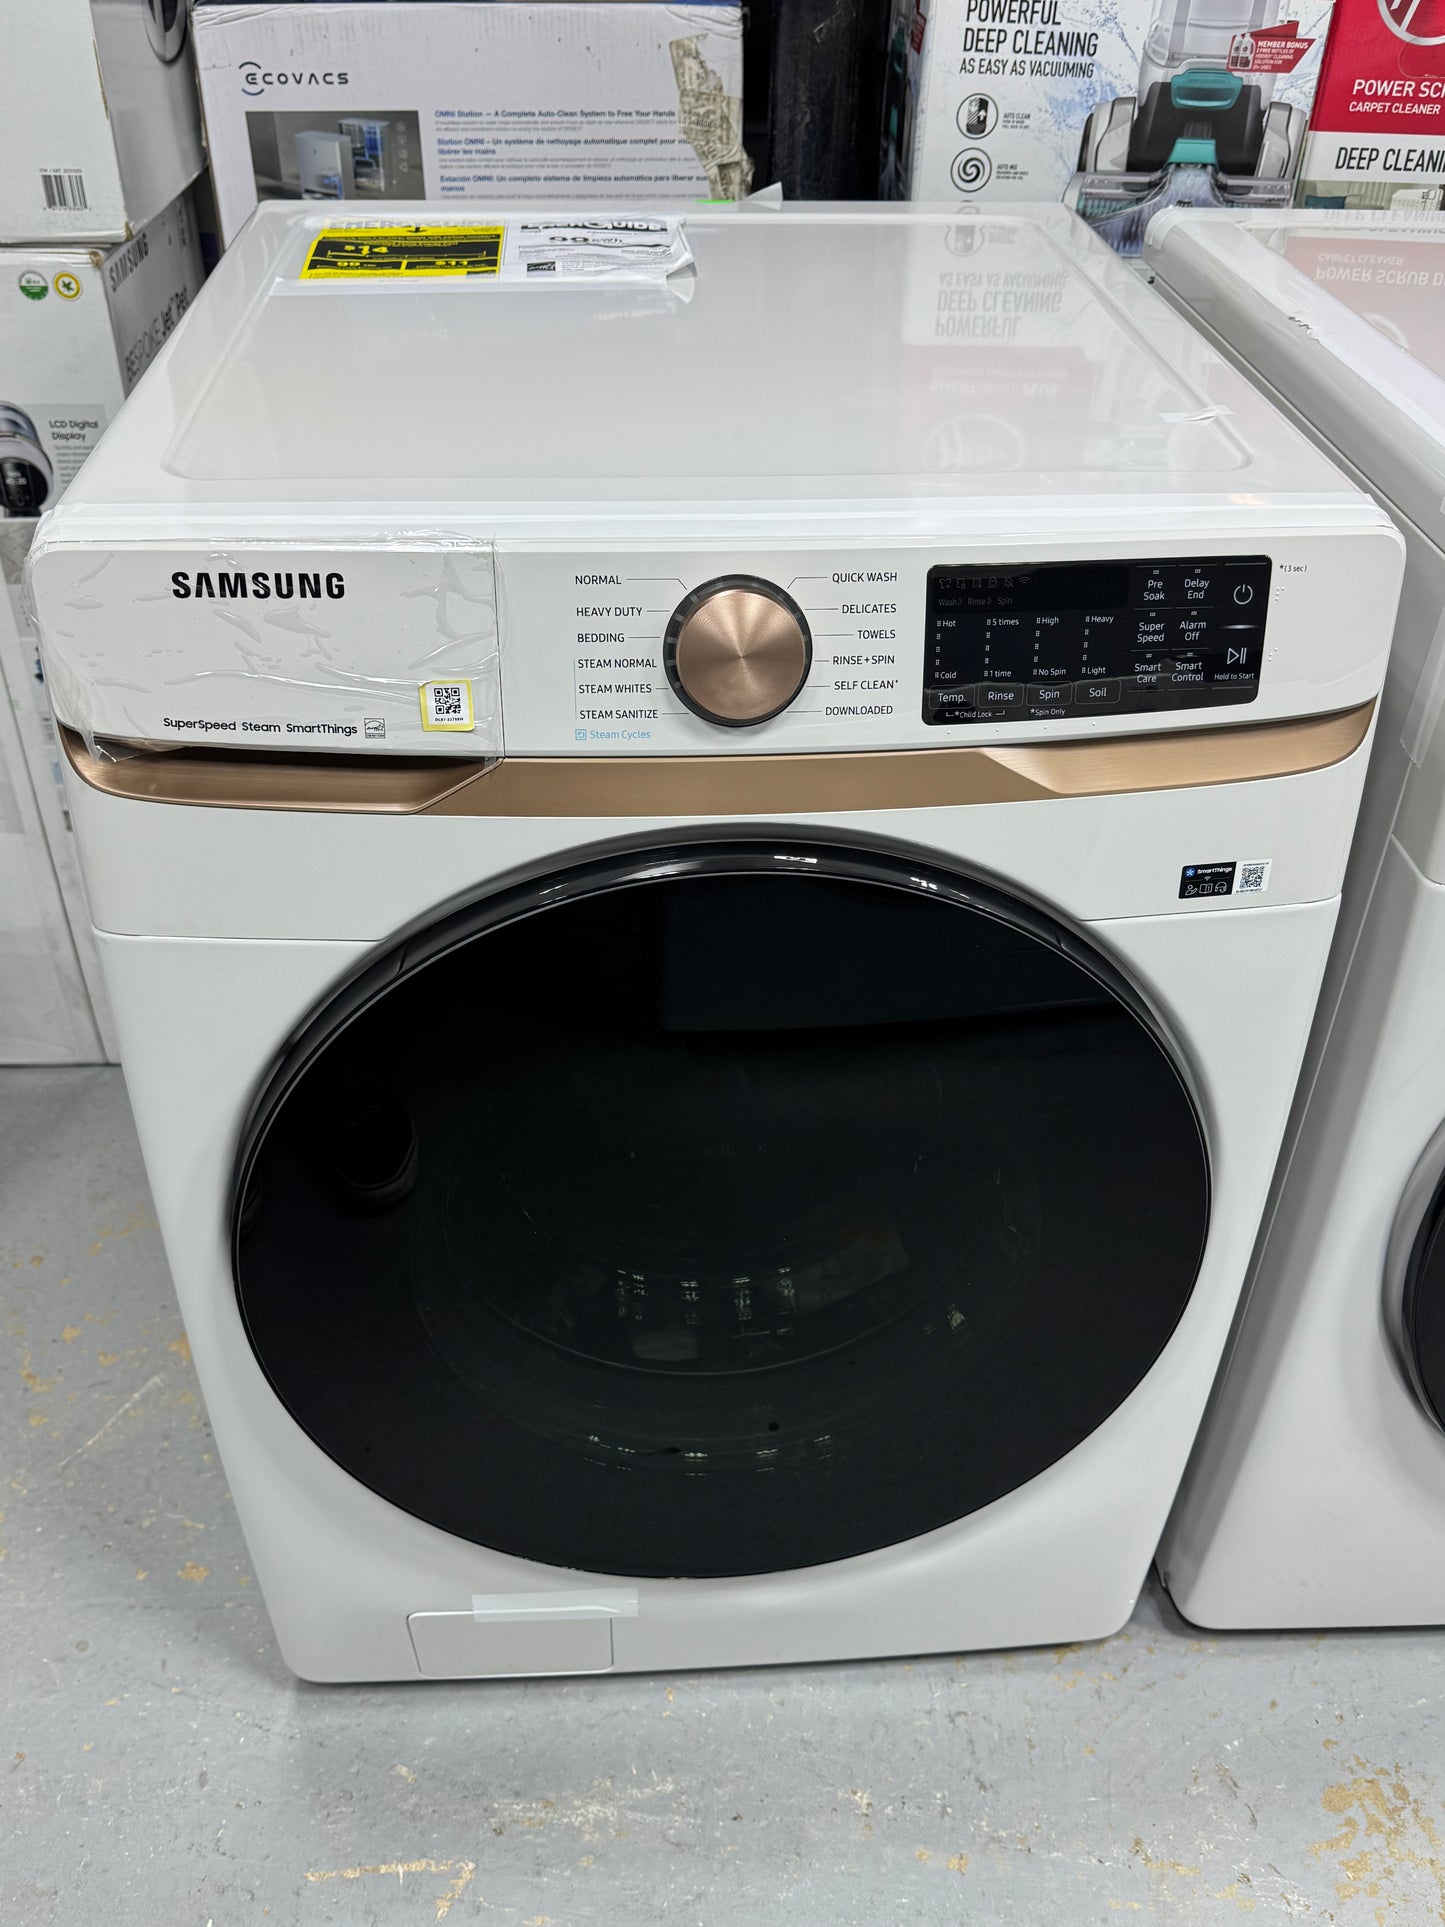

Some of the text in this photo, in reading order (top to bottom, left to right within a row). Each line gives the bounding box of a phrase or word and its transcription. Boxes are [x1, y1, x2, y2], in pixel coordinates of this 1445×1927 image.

[966, 0, 1061, 25] POWERFUL
[962, 28, 1099, 57] DEEP CLEANING
[1257, 40, 1309, 49] MEMBER BONUS
[959, 58, 1095, 79] AS EASY AS VACUUMING
[1352, 79, 1416, 97] POWER
[1348, 101, 1441, 115] CARPET CLEANER
[1335, 146, 1380, 170] DEEP
[109, 231, 149, 293] SAMSUNG
[575, 575, 622, 585] NORMAL
[832, 572, 898, 584] QUICK WASH
[172, 571, 346, 600] SAMSUNG
[1147, 579, 1163, 589] Pre
[1184, 578, 1210, 590] Delay
[1143, 591, 1165, 601] Soak
[1187, 590, 1205, 600] End
[938, 598, 958, 607] Wash
[967, 597, 986, 606] Rinse
[996, 596, 1013, 606] Spin
[576, 606, 643, 617] HEAVY DUTY
[842, 603, 897, 614] DELICATES
[942, 619, 956, 628] Hot
[992, 617, 1020, 626] 5 times
[1041, 616, 1060, 626] High
[1090, 615, 1114, 624] Heavy
[1139, 622, 1165, 633] Super
[1179, 621, 1207, 630] Alarm
[577, 632, 625, 643] BEDDING
[857, 629, 896, 640] TOWELS
[1137, 633, 1165, 644] Speed
[1184, 631, 1200, 641] Off
[577, 658, 658, 669] STEAM NORMAL
[832, 655, 863, 665] RINSE
[871, 654, 896, 665] SPIN
[1087, 666, 1106, 676] Light
[1134, 662, 1162, 672] Smart
[1175, 661, 1203, 671] Smart
[940, 671, 957, 680] Cold
[994, 669, 1012, 678] time
[1038, 668, 1067, 677] No Spin
[1171, 672, 1204, 682] Control
[1214, 673, 1229, 681] Hold
[1136, 674, 1157, 683] Care
[578, 683, 652, 694] STEAM WHITES
[834, 680, 859, 690] SELF
[987, 691, 1015, 701] Rinse
[1039, 689, 1060, 700] Spin
[1088, 687, 1107, 698] Soil
[938, 692, 967, 704] Temp.
[579, 709, 659, 720] STEAM SANITIZE
[825, 705, 894, 716] DOWNLOADED
[976, 710, 993, 718] Lock
[1049, 707, 1066, 716] Only
[163, 717, 358, 737] SuperSpeed Steam SmartThings
[590, 729, 651, 742] Steam Cycles
[1196, 866, 1233, 875] SmartThings
